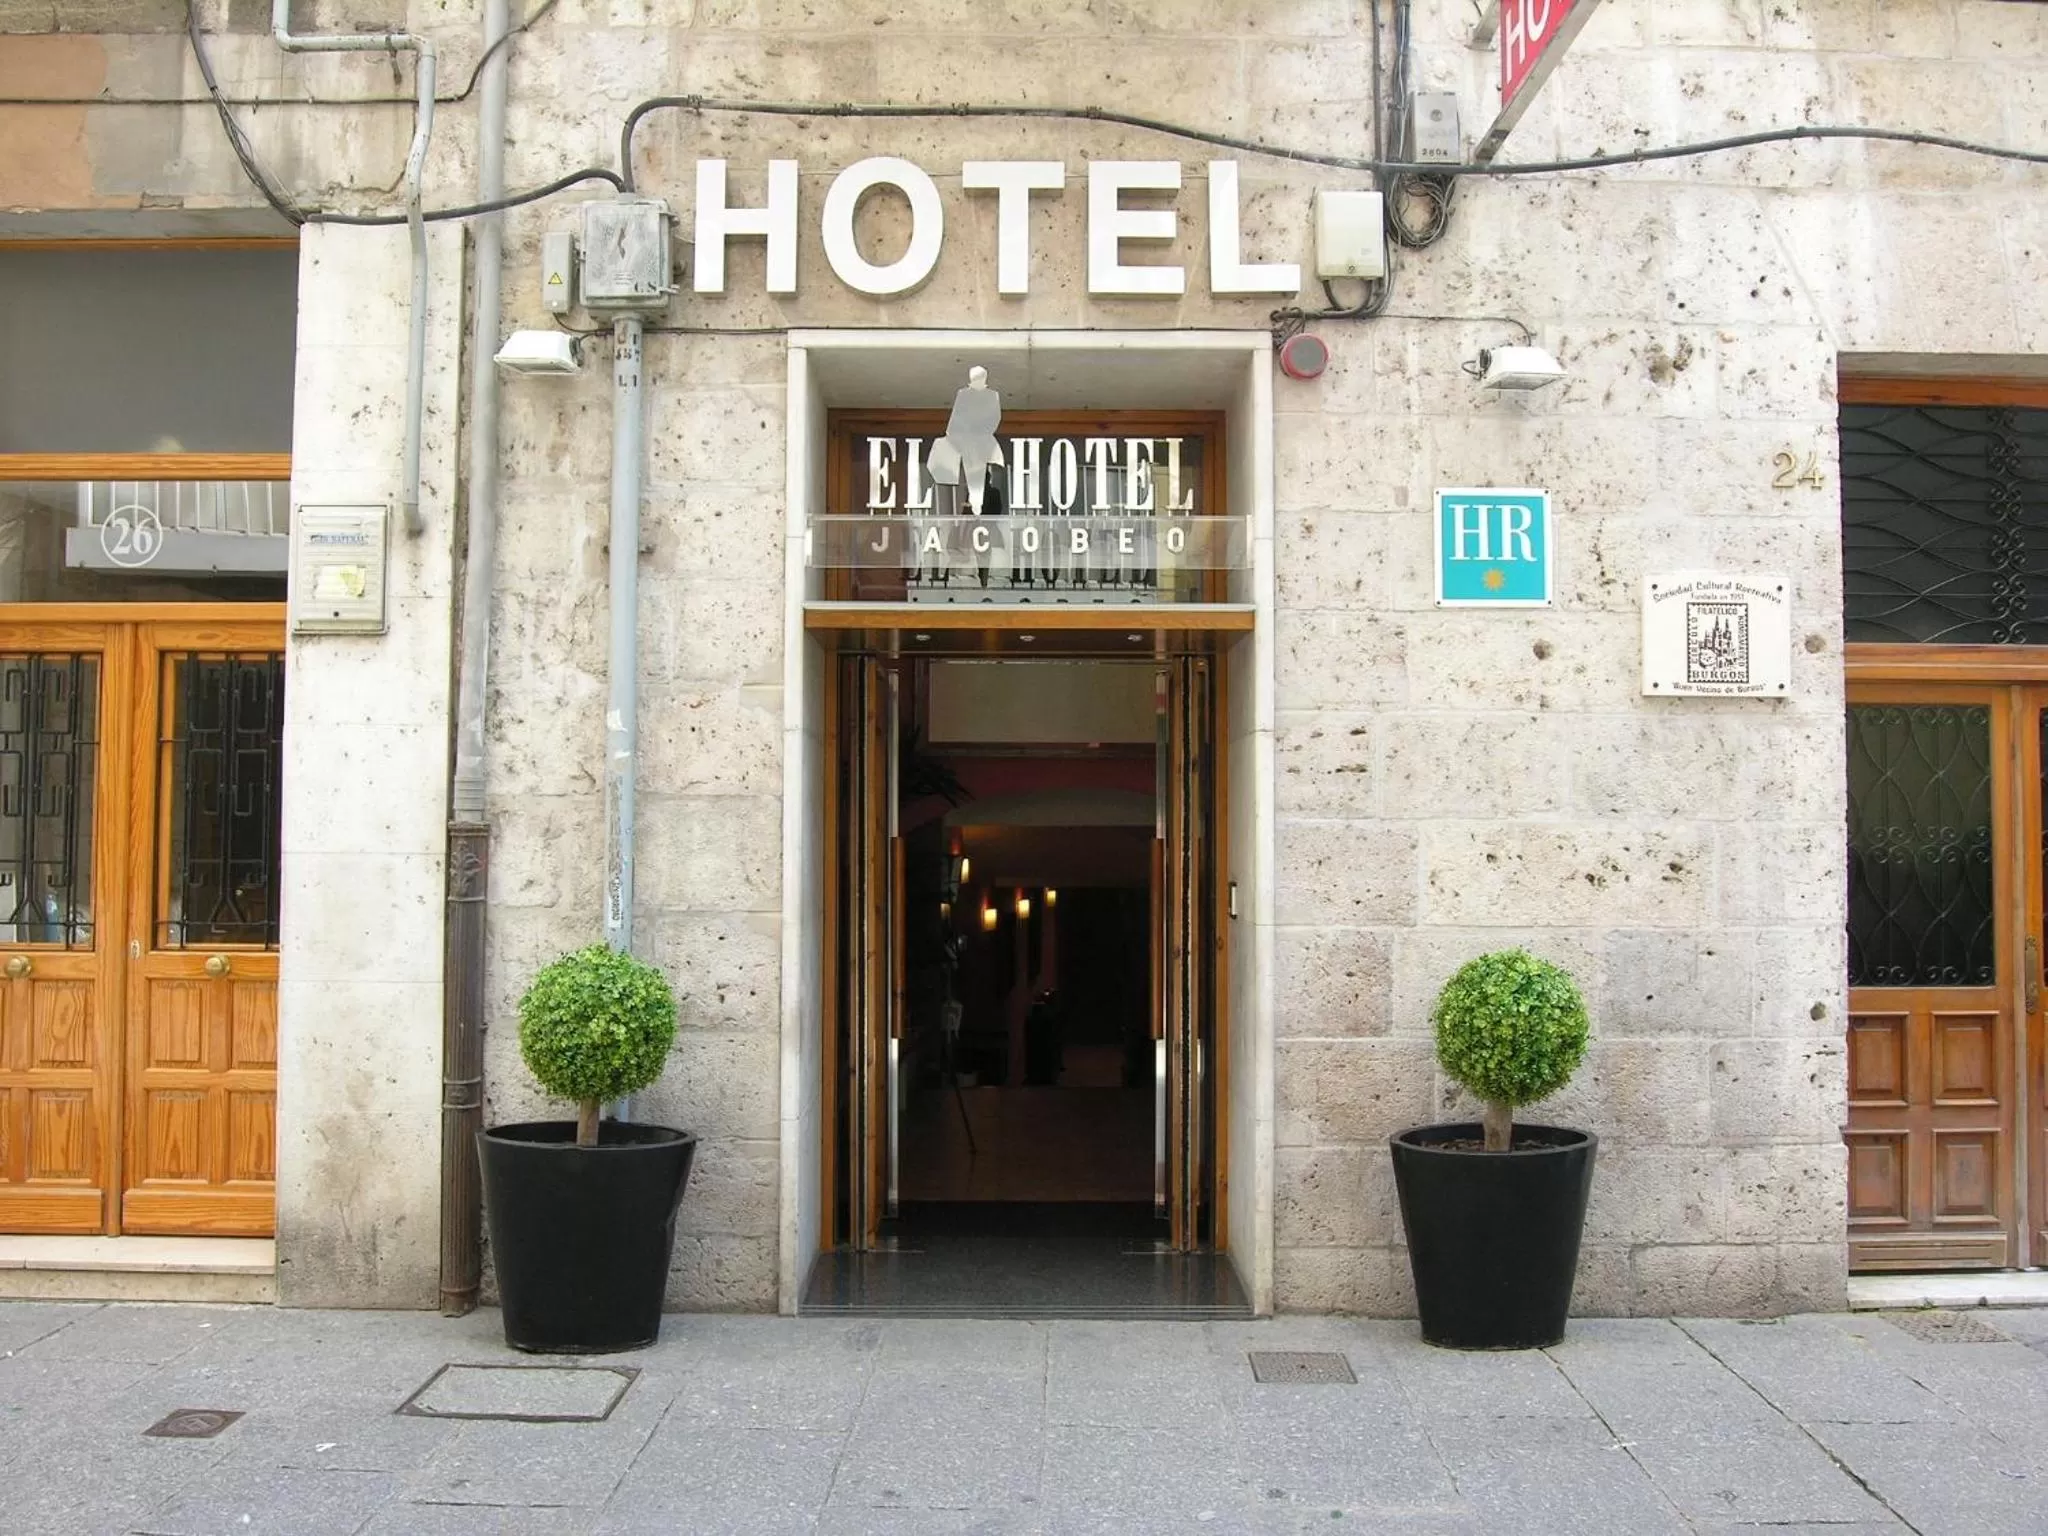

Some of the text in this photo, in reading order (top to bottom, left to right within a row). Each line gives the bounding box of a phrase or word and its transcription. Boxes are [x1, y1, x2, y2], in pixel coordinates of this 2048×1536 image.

[1506, 0, 1562, 84] HO
[693, 156, 1301, 295] HOTEL
[865, 436, 1195, 511] EL HOTEL
[1771, 451, 1825, 490] 24
[111, 517, 154, 555] 26
[871, 525, 1187, 555] JACOBEO
[1448, 504, 1538, 562] HR
[1652, 580, 1781, 604] Sociedad Cultural Recreativa
[1691, 616, 1699, 665] CIRCULO
[1692, 671, 1745, 680] BURGOS
[1724, 686, 1735, 694] de
